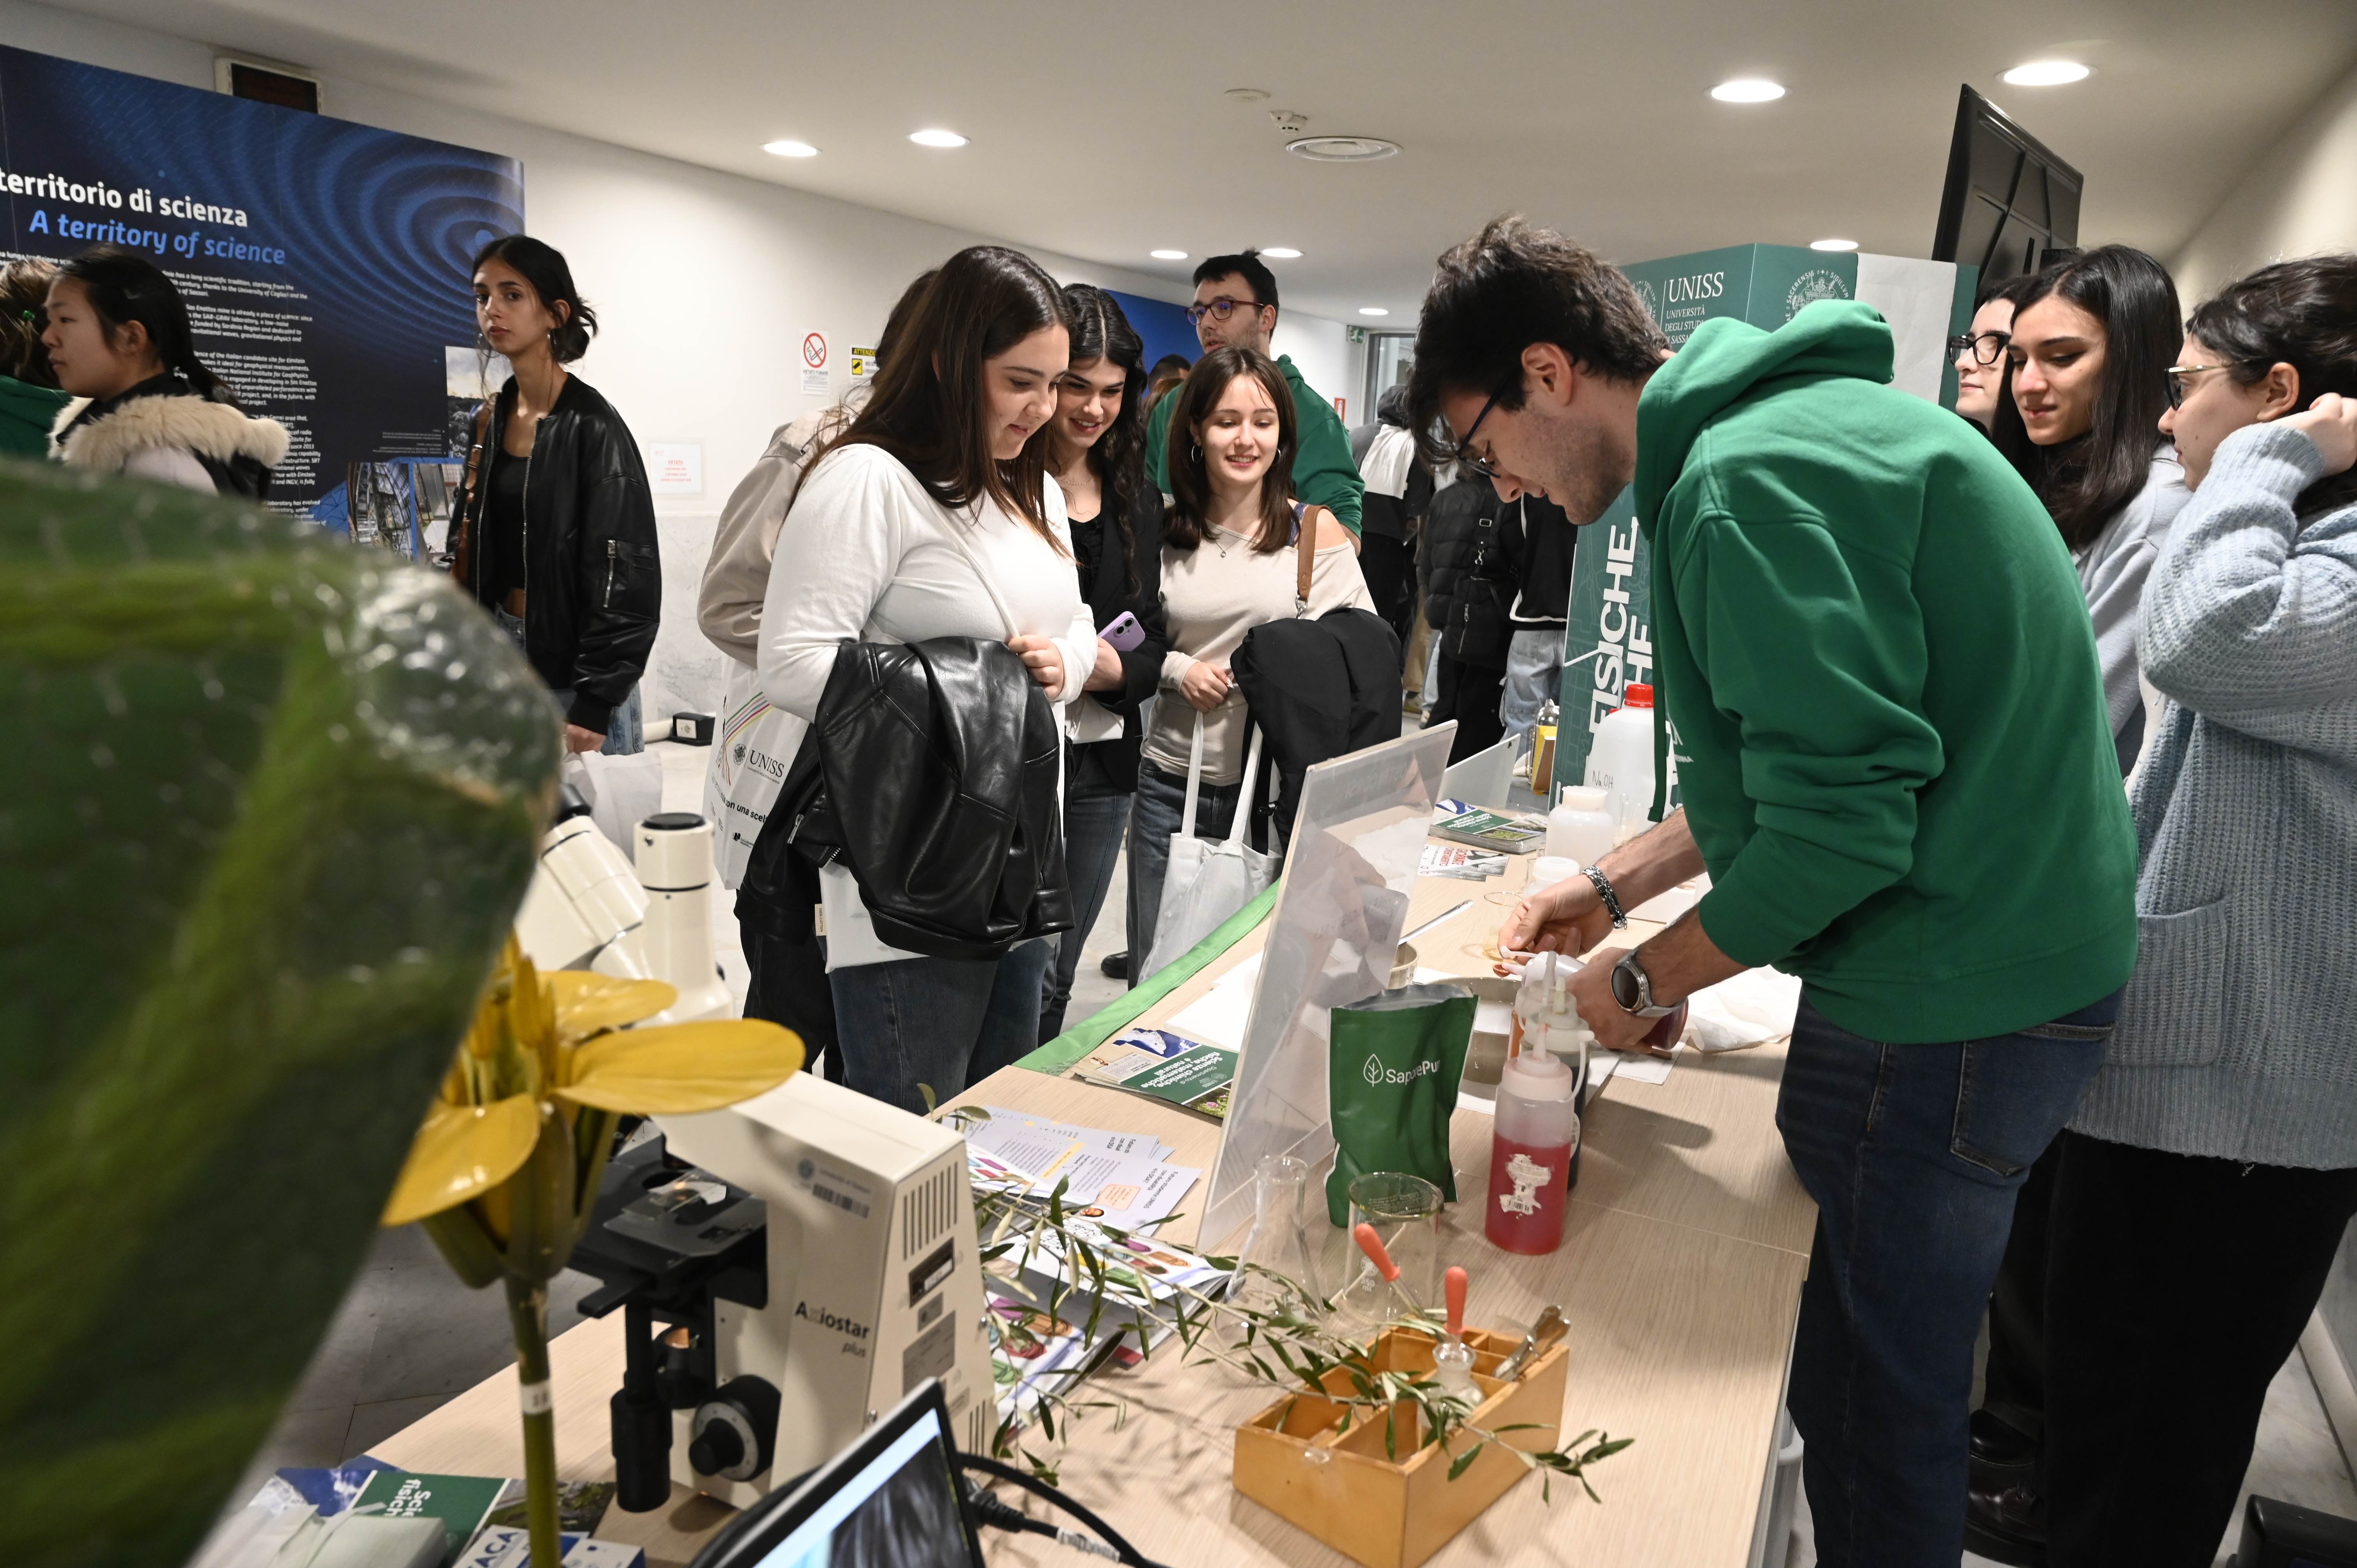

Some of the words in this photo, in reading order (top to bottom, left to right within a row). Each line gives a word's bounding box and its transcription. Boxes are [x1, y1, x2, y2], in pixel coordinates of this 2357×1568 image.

[0, 168, 122, 208] territorio
[129, 188, 152, 213] di
[159, 196, 248, 228] scienza
[29, 210, 49, 233] A
[58, 213, 168, 254] territory
[174, 231, 200, 259] of
[205, 237, 286, 264] science
[237, 287, 263, 296] University
[1669, 271, 1724, 302] UNISS
[1830, 272, 1849, 298] SIGILLVM
[1666, 304, 1705, 319] UNIVERSITÀ
[194, 321, 213, 330] funded
[1665, 322, 1683, 332] DEGLI
[1671, 334, 1692, 344] SASSA
[750, 750, 784, 778] UNISS
[737, 804, 749, 816] una
[1154, 1060, 1185, 1077] naturali
[1192, 1056, 1223, 1072] Scienze
[1140, 1063, 1192, 1088] matematiche
[795, 1301, 870, 1339] Aiostar
[467, 1531, 519, 1568] ACA
